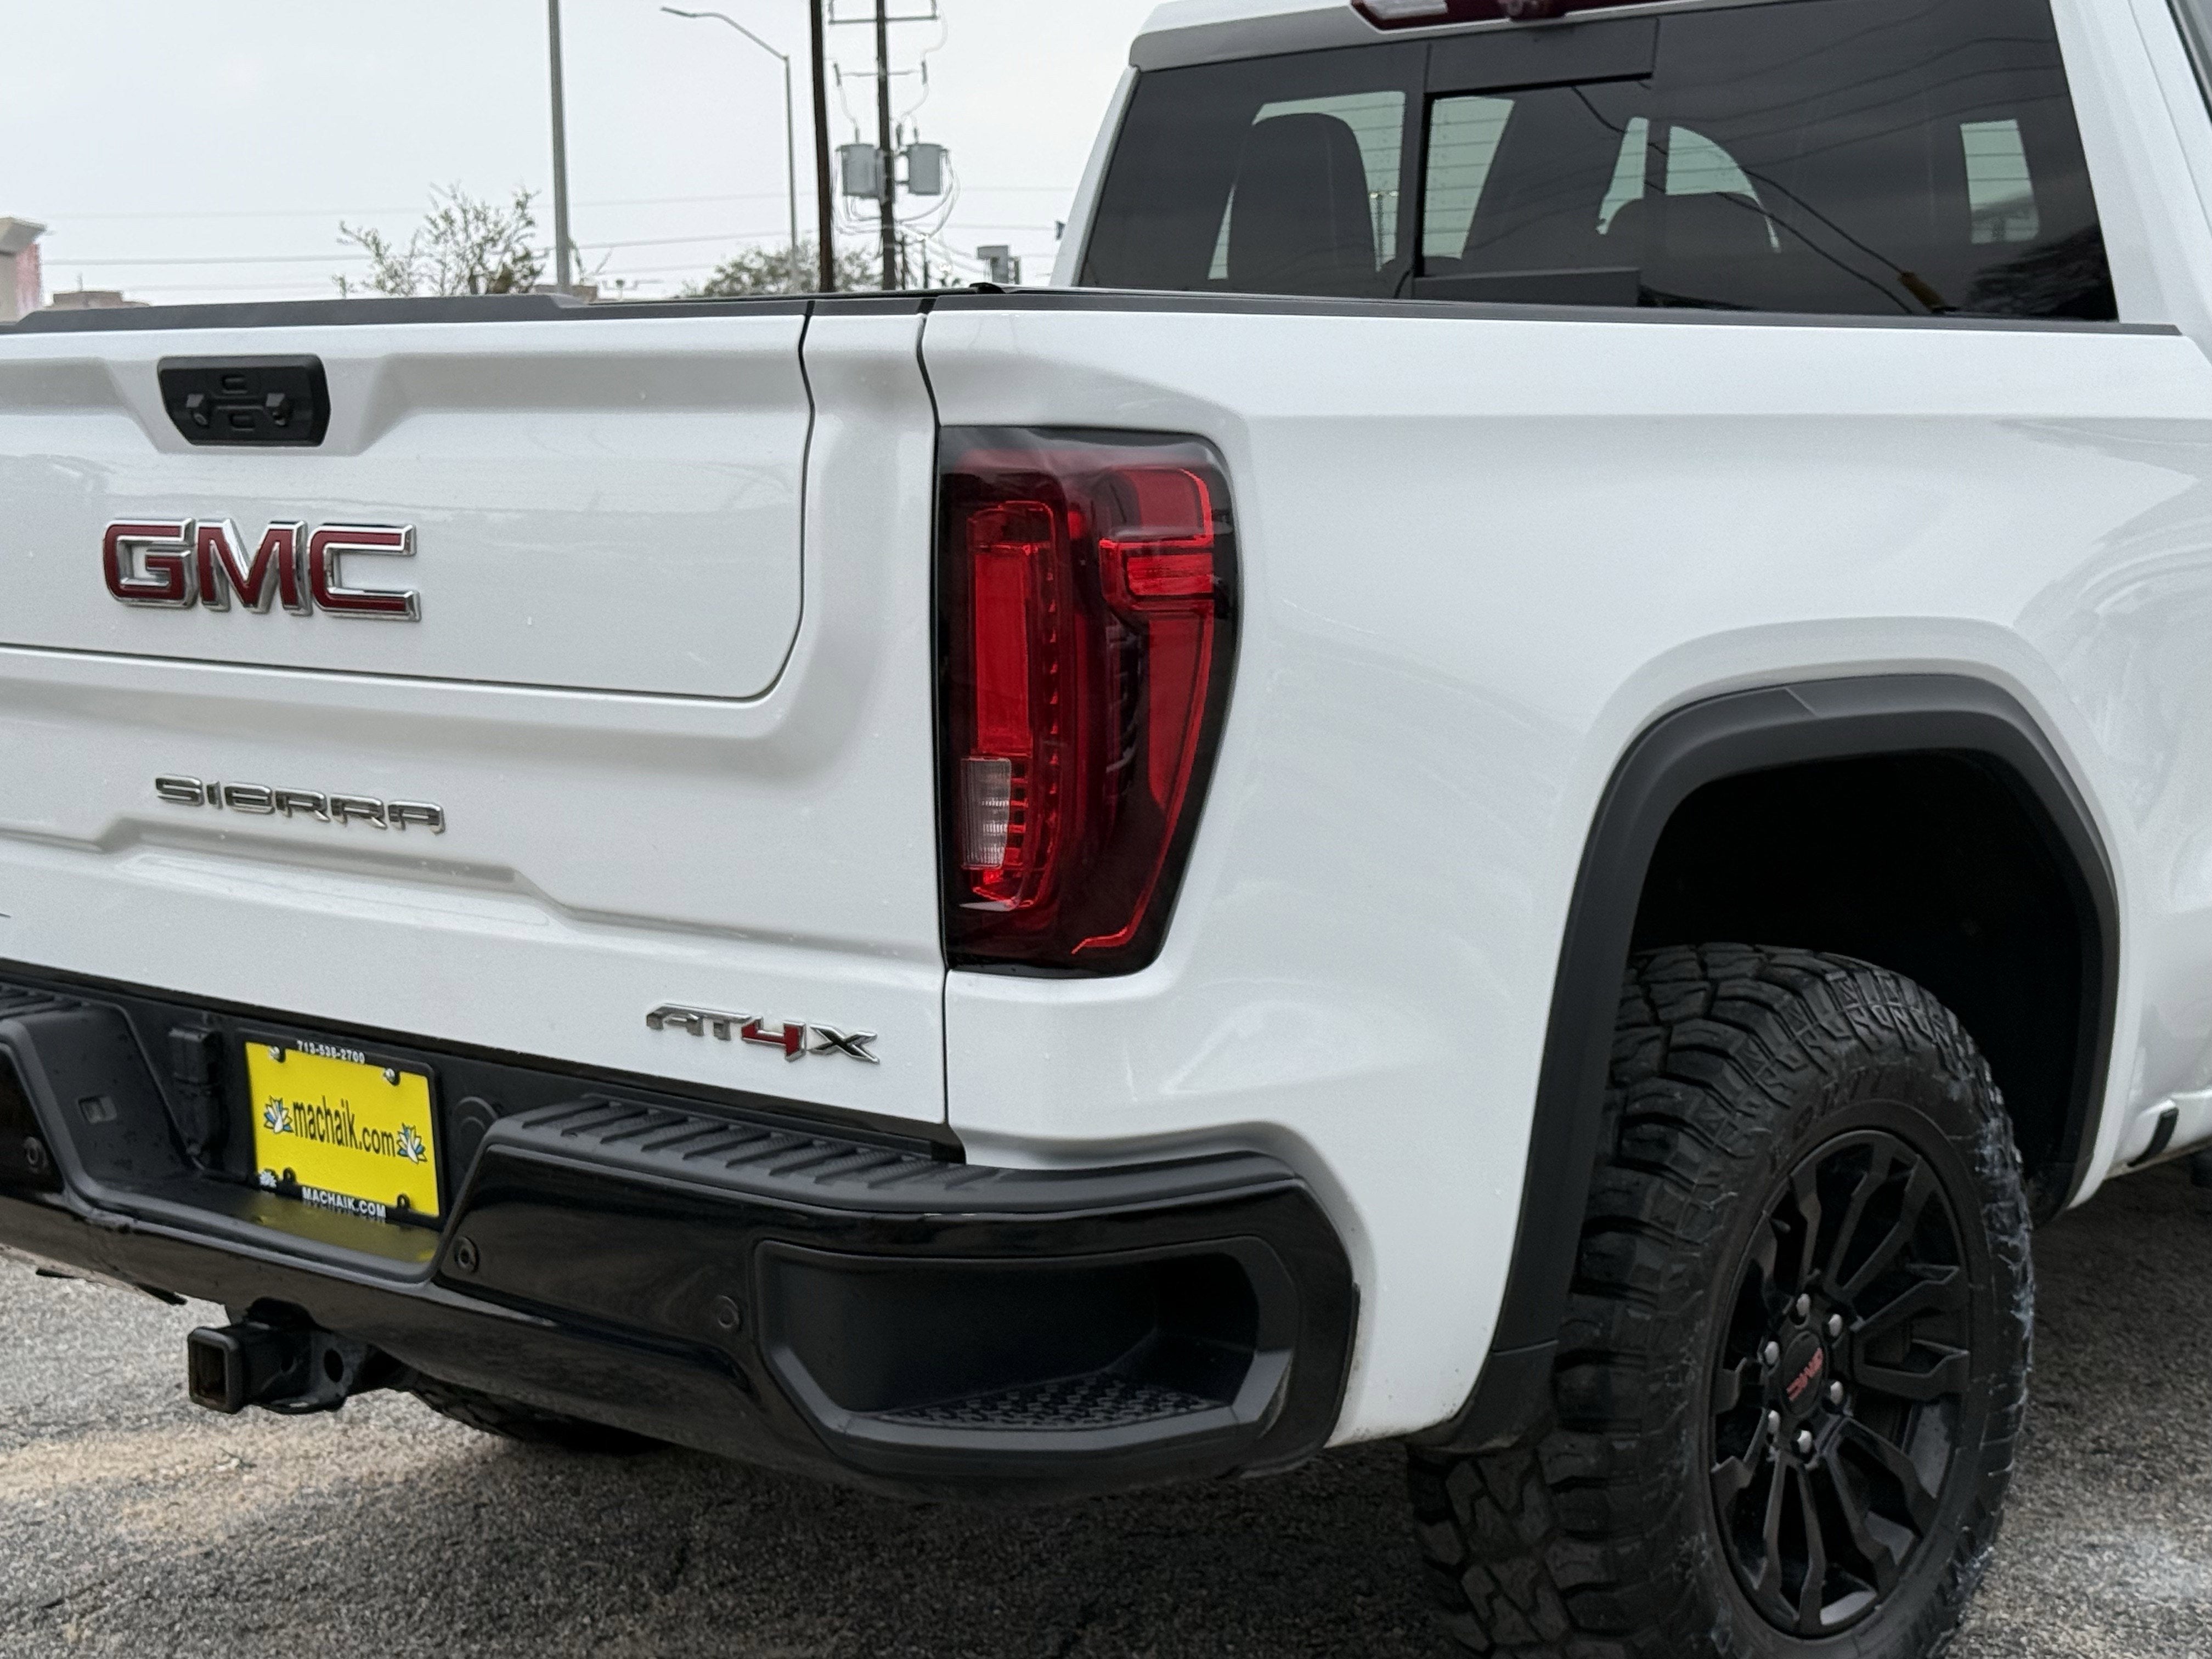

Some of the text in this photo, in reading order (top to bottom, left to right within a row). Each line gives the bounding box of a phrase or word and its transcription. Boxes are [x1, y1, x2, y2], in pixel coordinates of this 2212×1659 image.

[103, 518, 422, 622] GMC
[155, 774, 445, 834] SIERRA
[646, 1003, 880, 1063] AT4X
[292, 1095, 396, 1158] machaik.com
[302, 1187, 386, 1218] MACHAIK.COM
